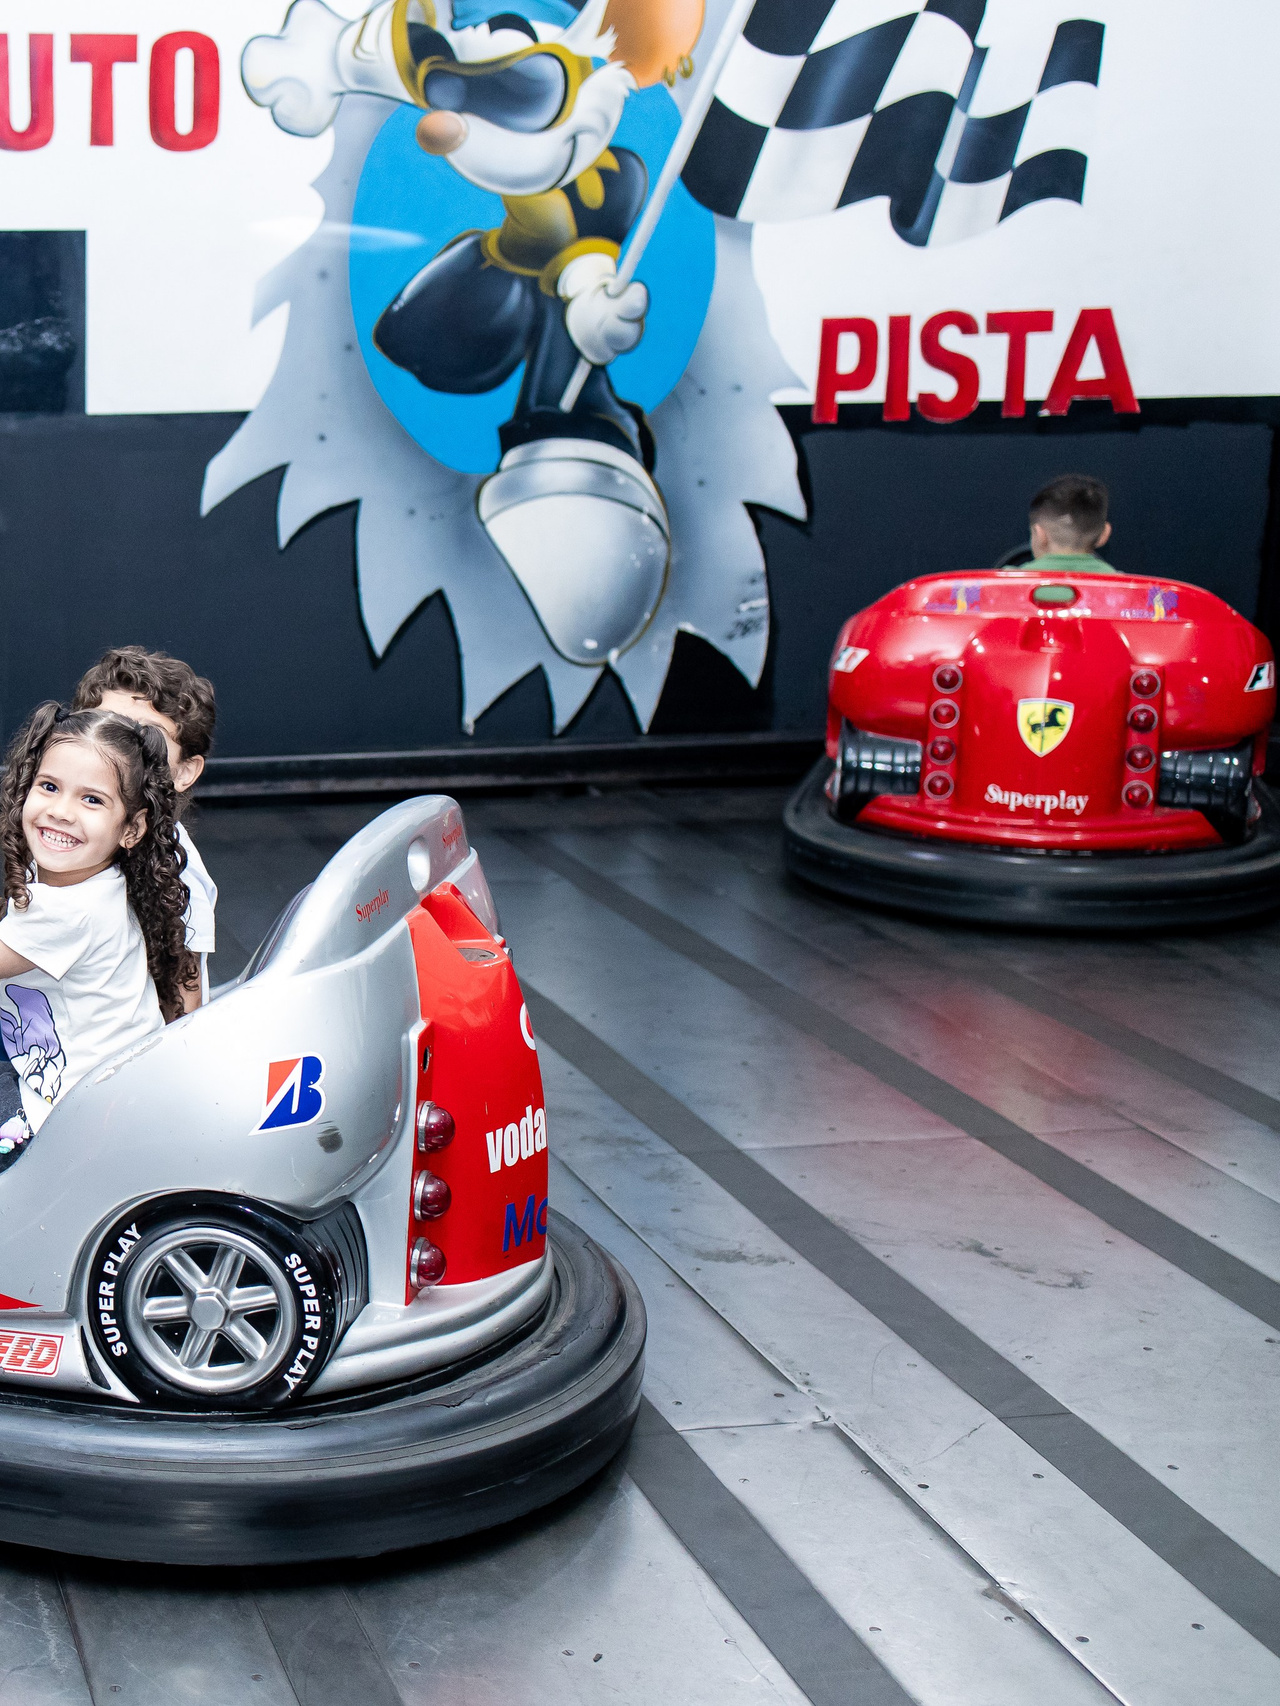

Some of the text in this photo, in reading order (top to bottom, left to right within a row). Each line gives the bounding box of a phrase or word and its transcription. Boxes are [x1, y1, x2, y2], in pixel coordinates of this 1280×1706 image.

[811, 307, 1141, 424] PISTA
[984, 783, 1089, 815] Superplay
[355, 889, 389, 922] Superplay
[486, 1105, 548, 1173] voda
[98, 1222, 142, 1357] SUPER PLAY
[282, 1252, 322, 1390] SUPER PLAY
